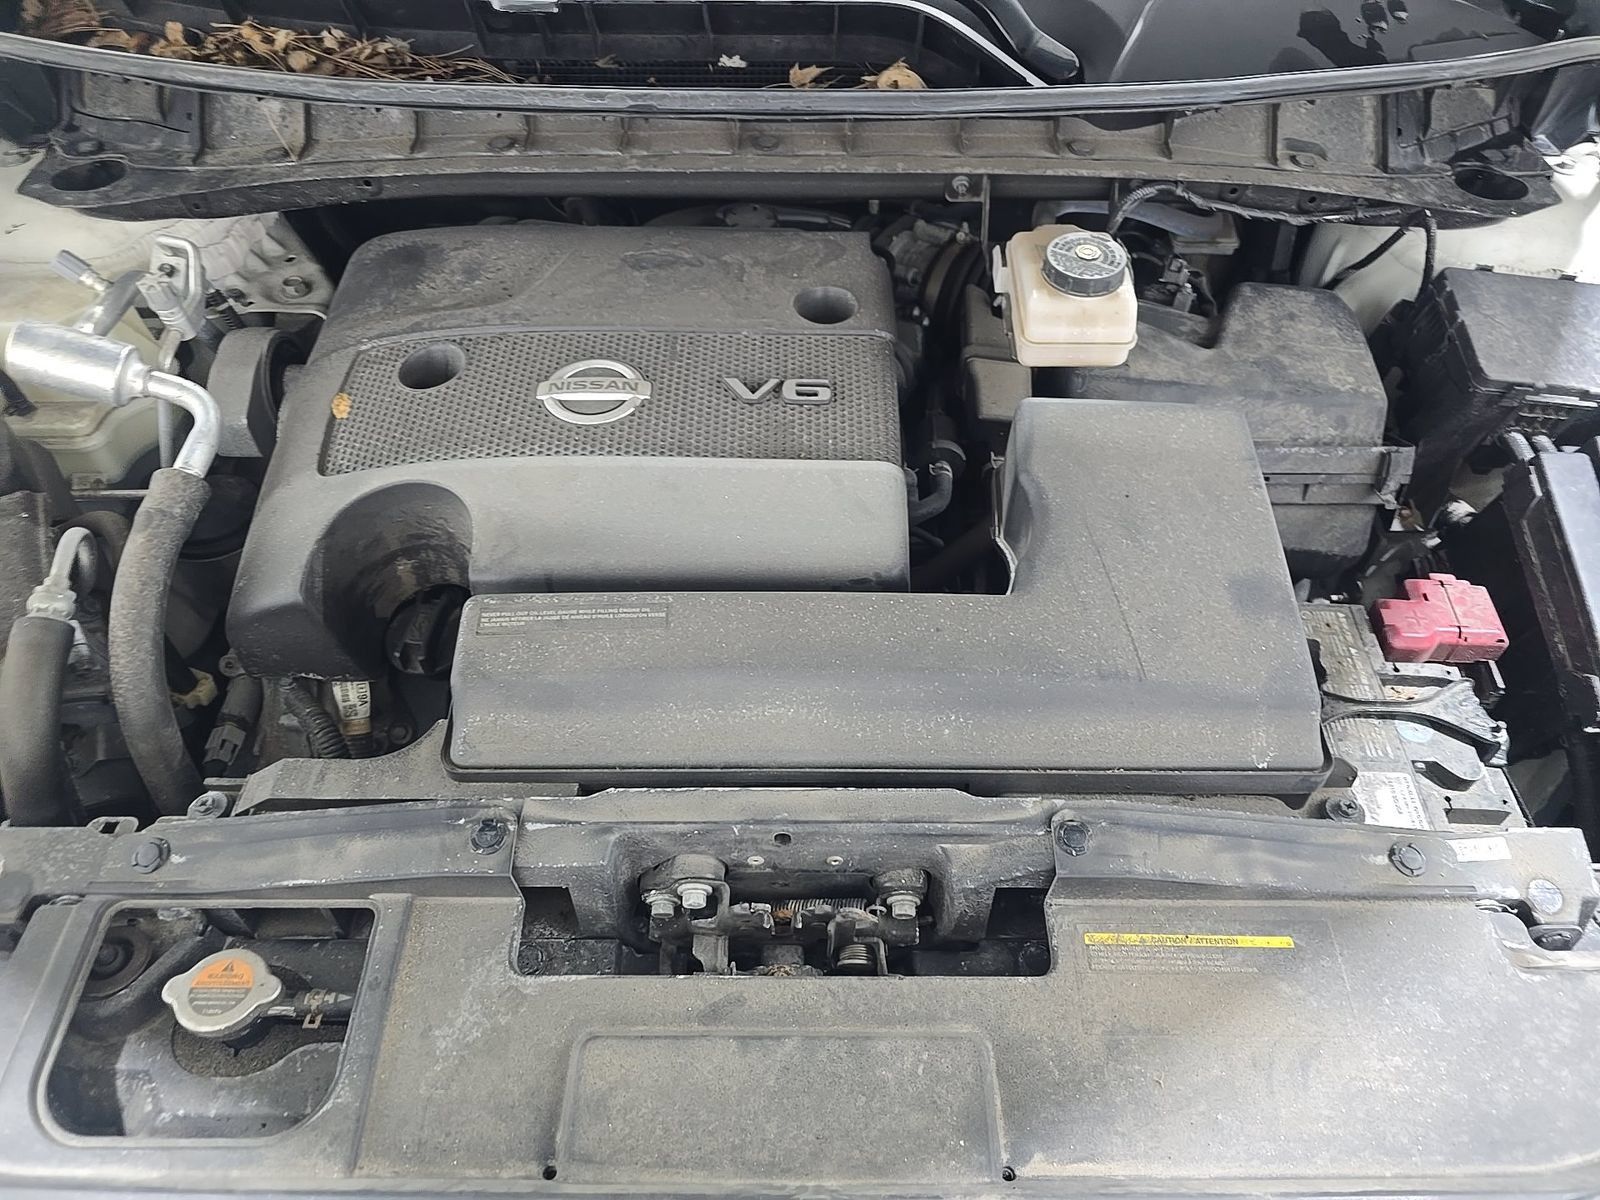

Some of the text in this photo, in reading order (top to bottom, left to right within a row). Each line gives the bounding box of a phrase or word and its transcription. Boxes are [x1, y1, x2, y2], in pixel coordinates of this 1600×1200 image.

[548, 379, 639, 392] NISSAN
[722, 377, 832, 405] V6
[1151, 936, 1187, 945] CAUTION
[1195, 937, 1239, 945] ATTENTION
